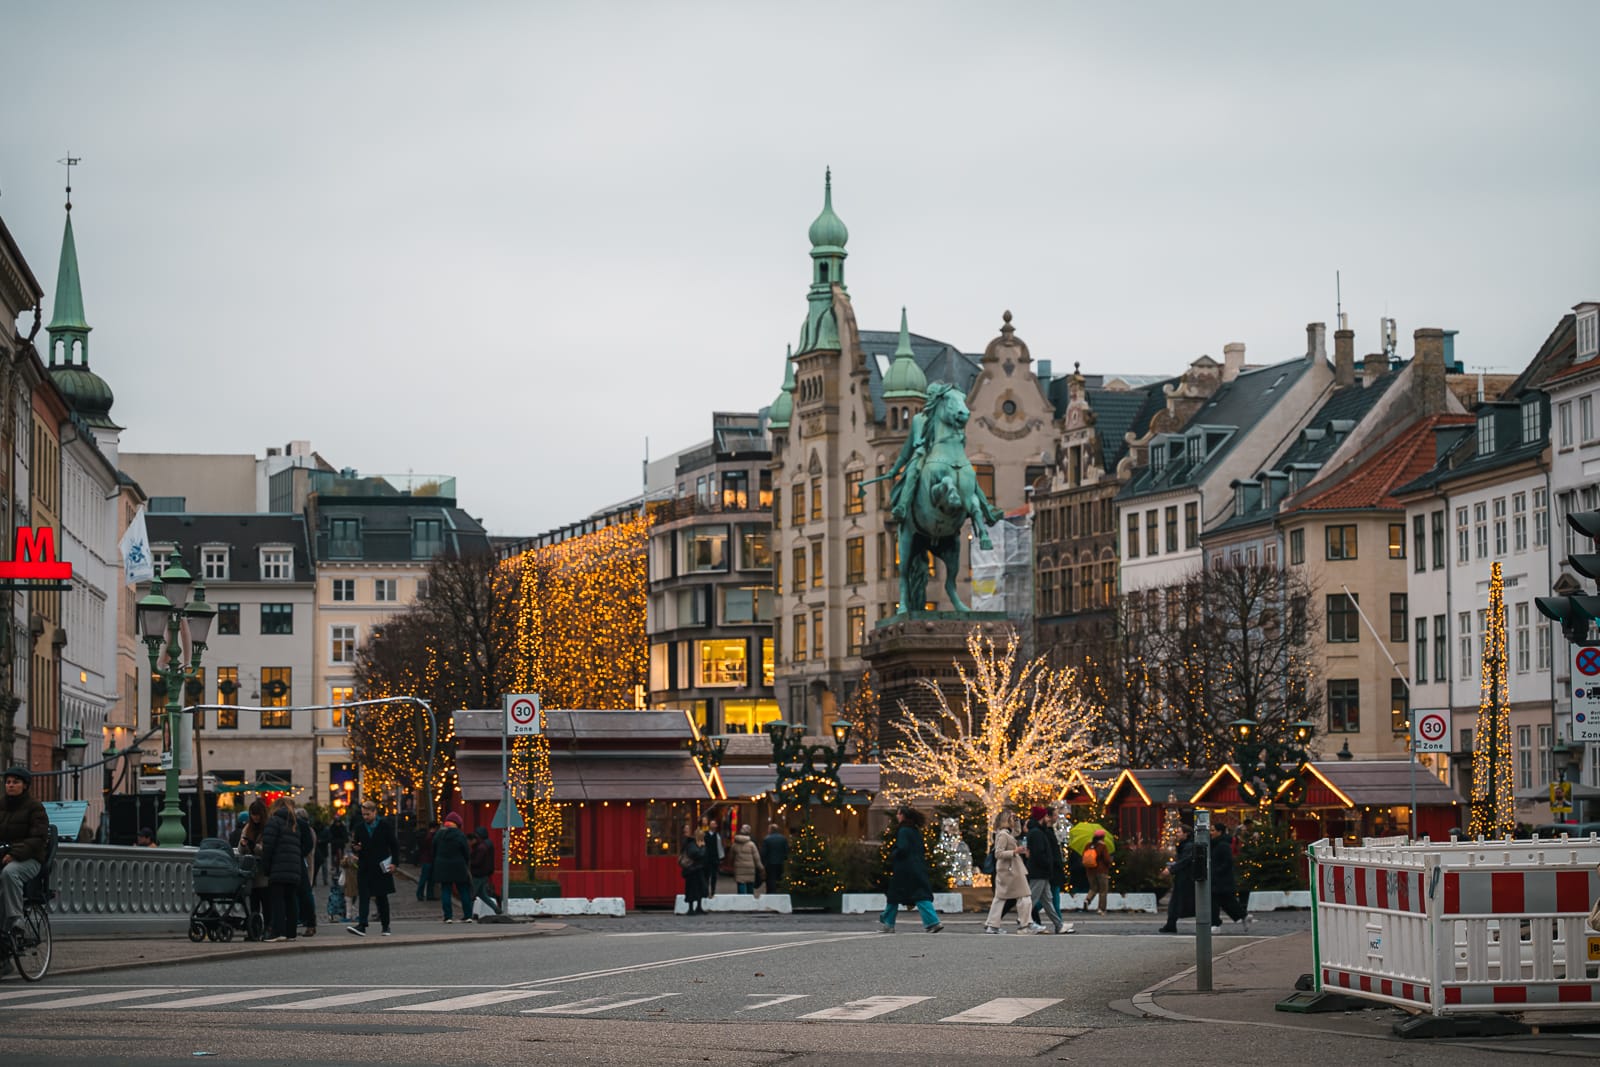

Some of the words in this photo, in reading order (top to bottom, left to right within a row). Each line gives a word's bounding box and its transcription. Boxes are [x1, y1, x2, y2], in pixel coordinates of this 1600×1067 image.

[15, 526, 55, 562] M
[516, 706, 531, 717] 30
[1424, 722, 1442, 733] 30
[1423, 742, 1444, 750] Zone
